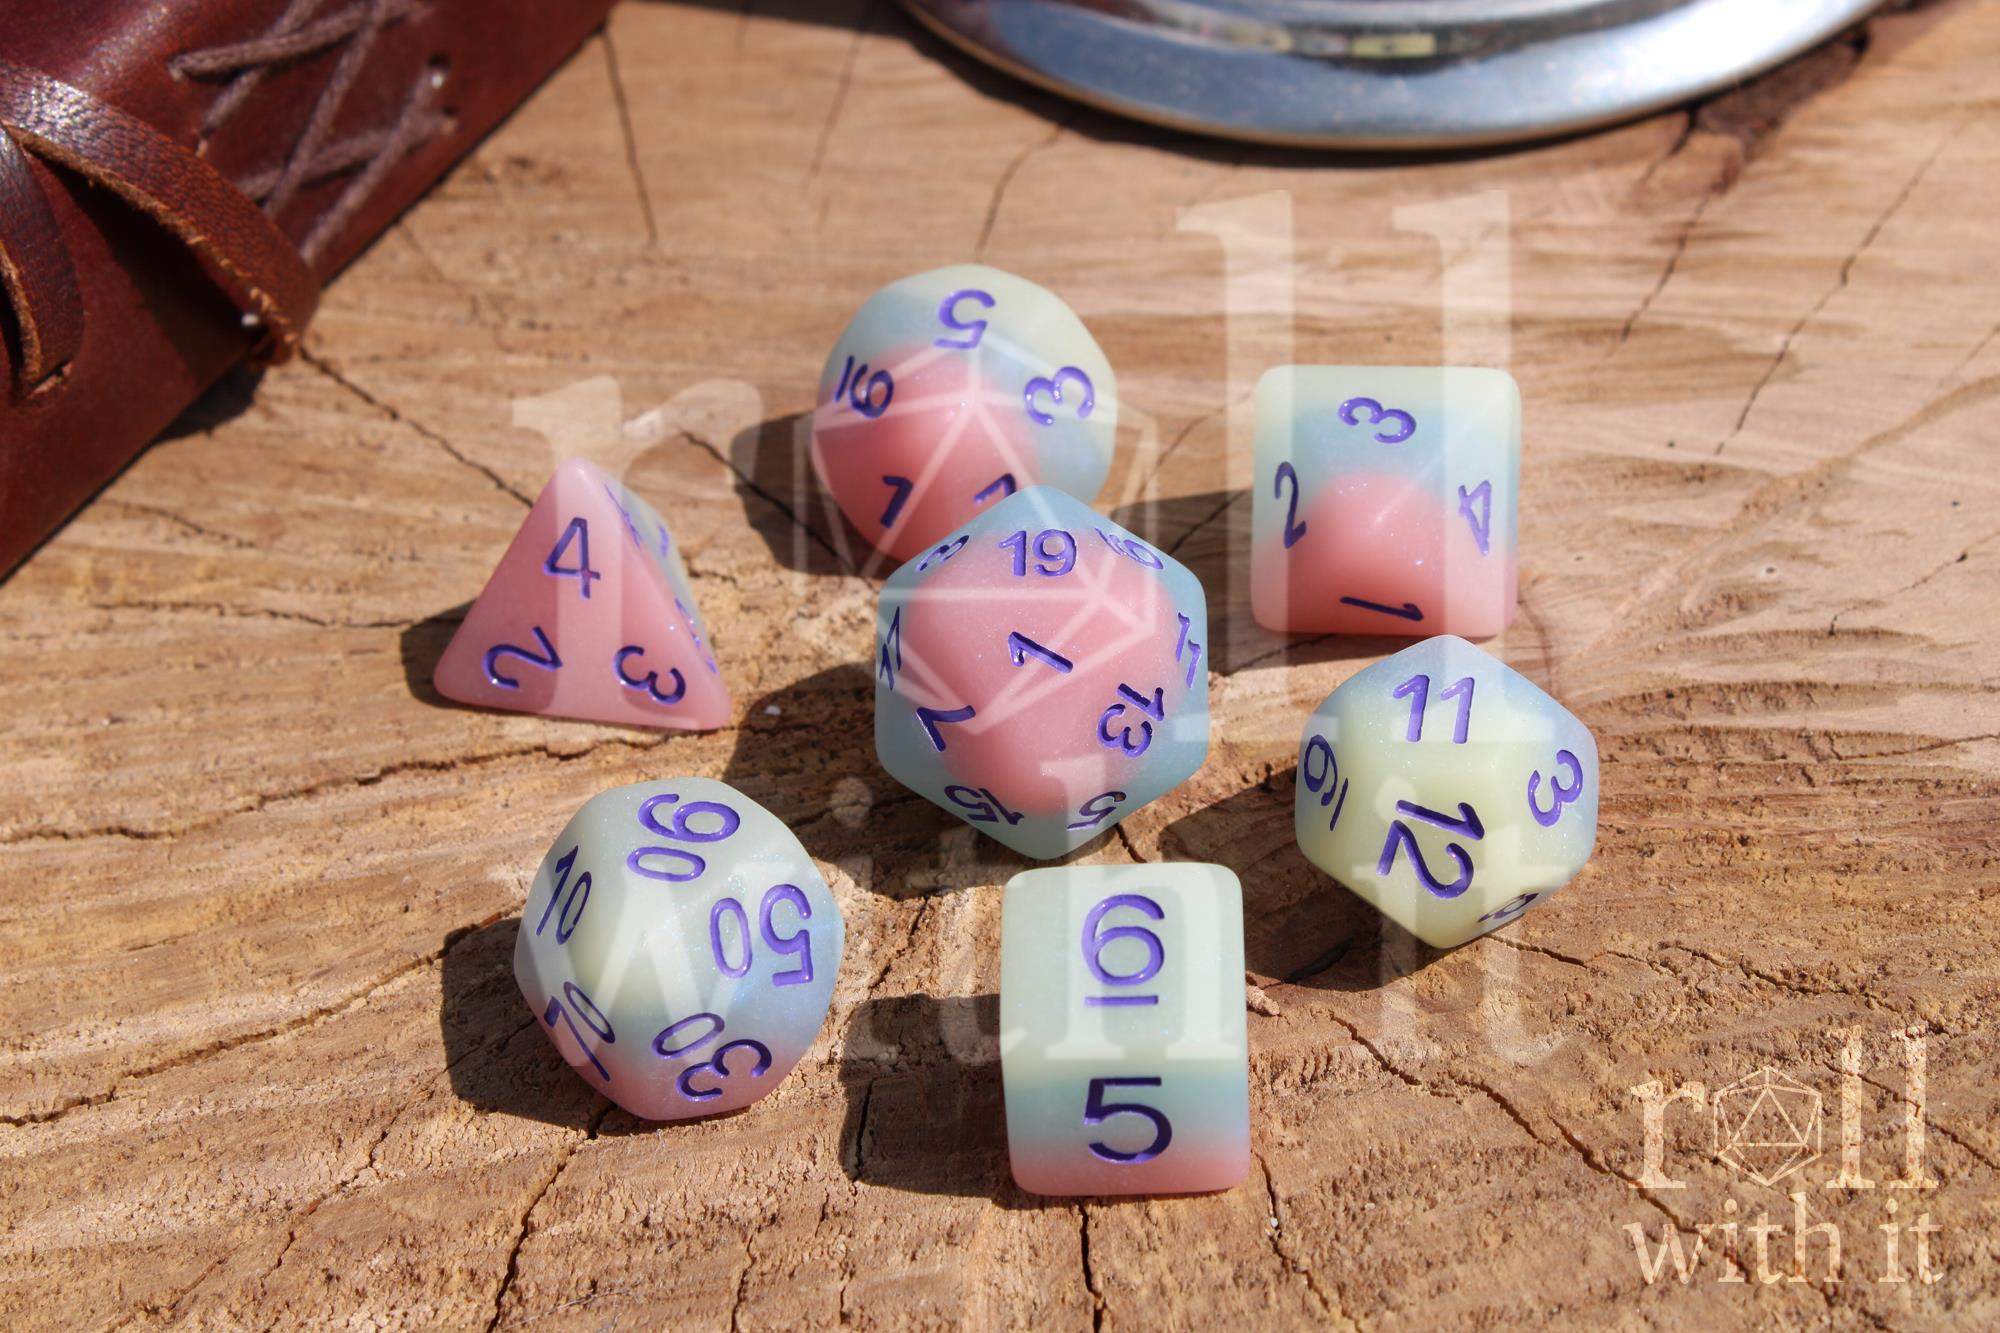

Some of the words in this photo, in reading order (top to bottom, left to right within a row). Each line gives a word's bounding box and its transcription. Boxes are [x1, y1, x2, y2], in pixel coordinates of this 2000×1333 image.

[933, 290, 996, 349] 5
[1024, 367, 1095, 426] 3
[1338, 397, 1416, 443] 3
[1274, 461, 1307, 549] 2
[1458, 480, 1492, 557] 4
[543, 517, 601, 599] 4
[998, 529, 1077, 577] 19
[1339, 596, 1424, 622] 1
[483, 626, 563, 689] 2
[613, 645, 686, 705] 3
[1008, 631, 1073, 674] 1
[916, 705, 976, 752] 7
[1098, 683, 1164, 757] 13
[1393, 674, 1475, 744] 11
[944, 785, 1024, 826] 15
[1066, 791, 1126, 831] 5
[1528, 749, 1583, 827] 3
[627, 794, 740, 882] 90
[1377, 800, 1485, 899] 12
[536, 845, 592, 945] 10
[710, 884, 813, 987] 50
[1081, 894, 1165, 1007] 6
[543, 981, 616, 1081] 70
[652, 1012, 772, 1102] 30
[1083, 1077, 1172, 1163] 5
